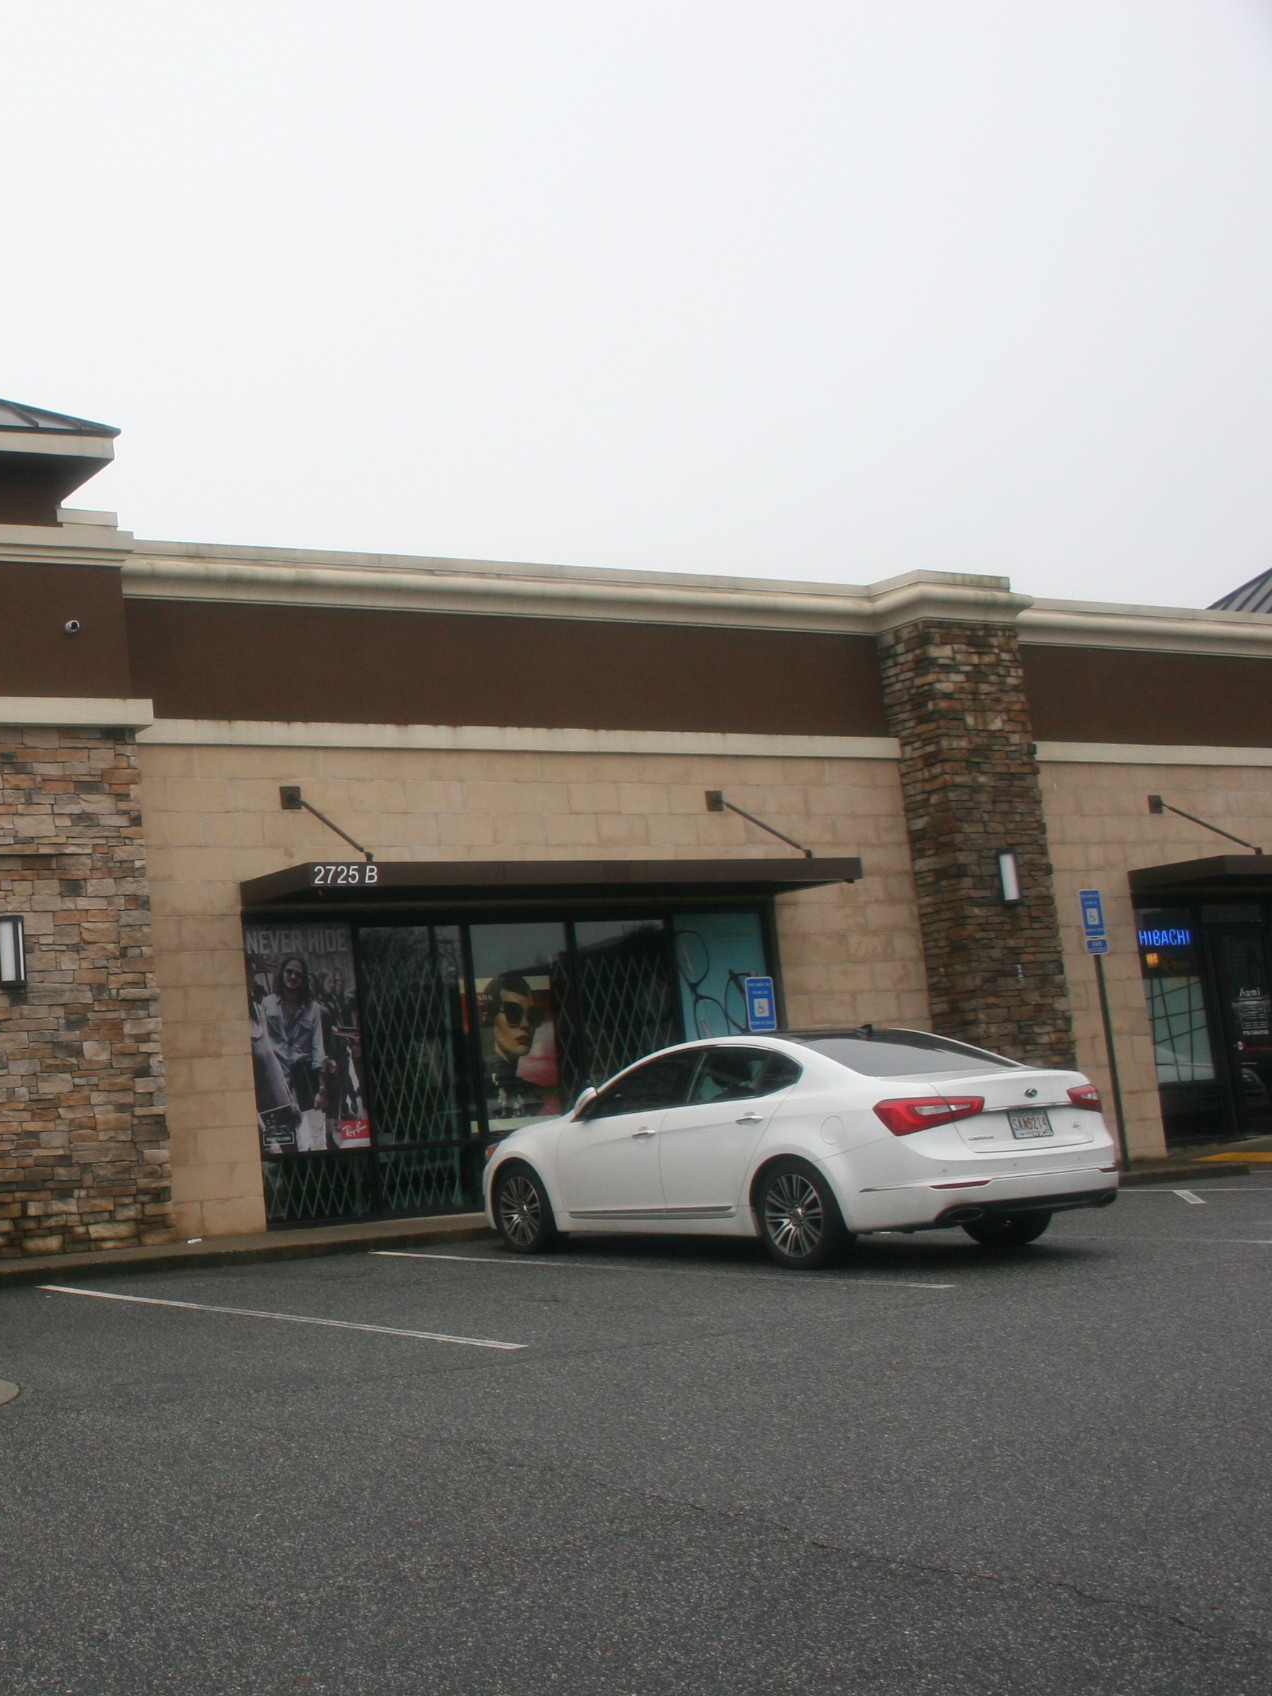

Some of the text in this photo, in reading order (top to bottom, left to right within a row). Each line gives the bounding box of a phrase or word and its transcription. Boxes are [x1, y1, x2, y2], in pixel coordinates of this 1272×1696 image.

[313, 865, 378, 885] 2725 B
[245, 928, 348, 955] NEVER HIDE
[1138, 928, 1190, 946] HIBACHI
